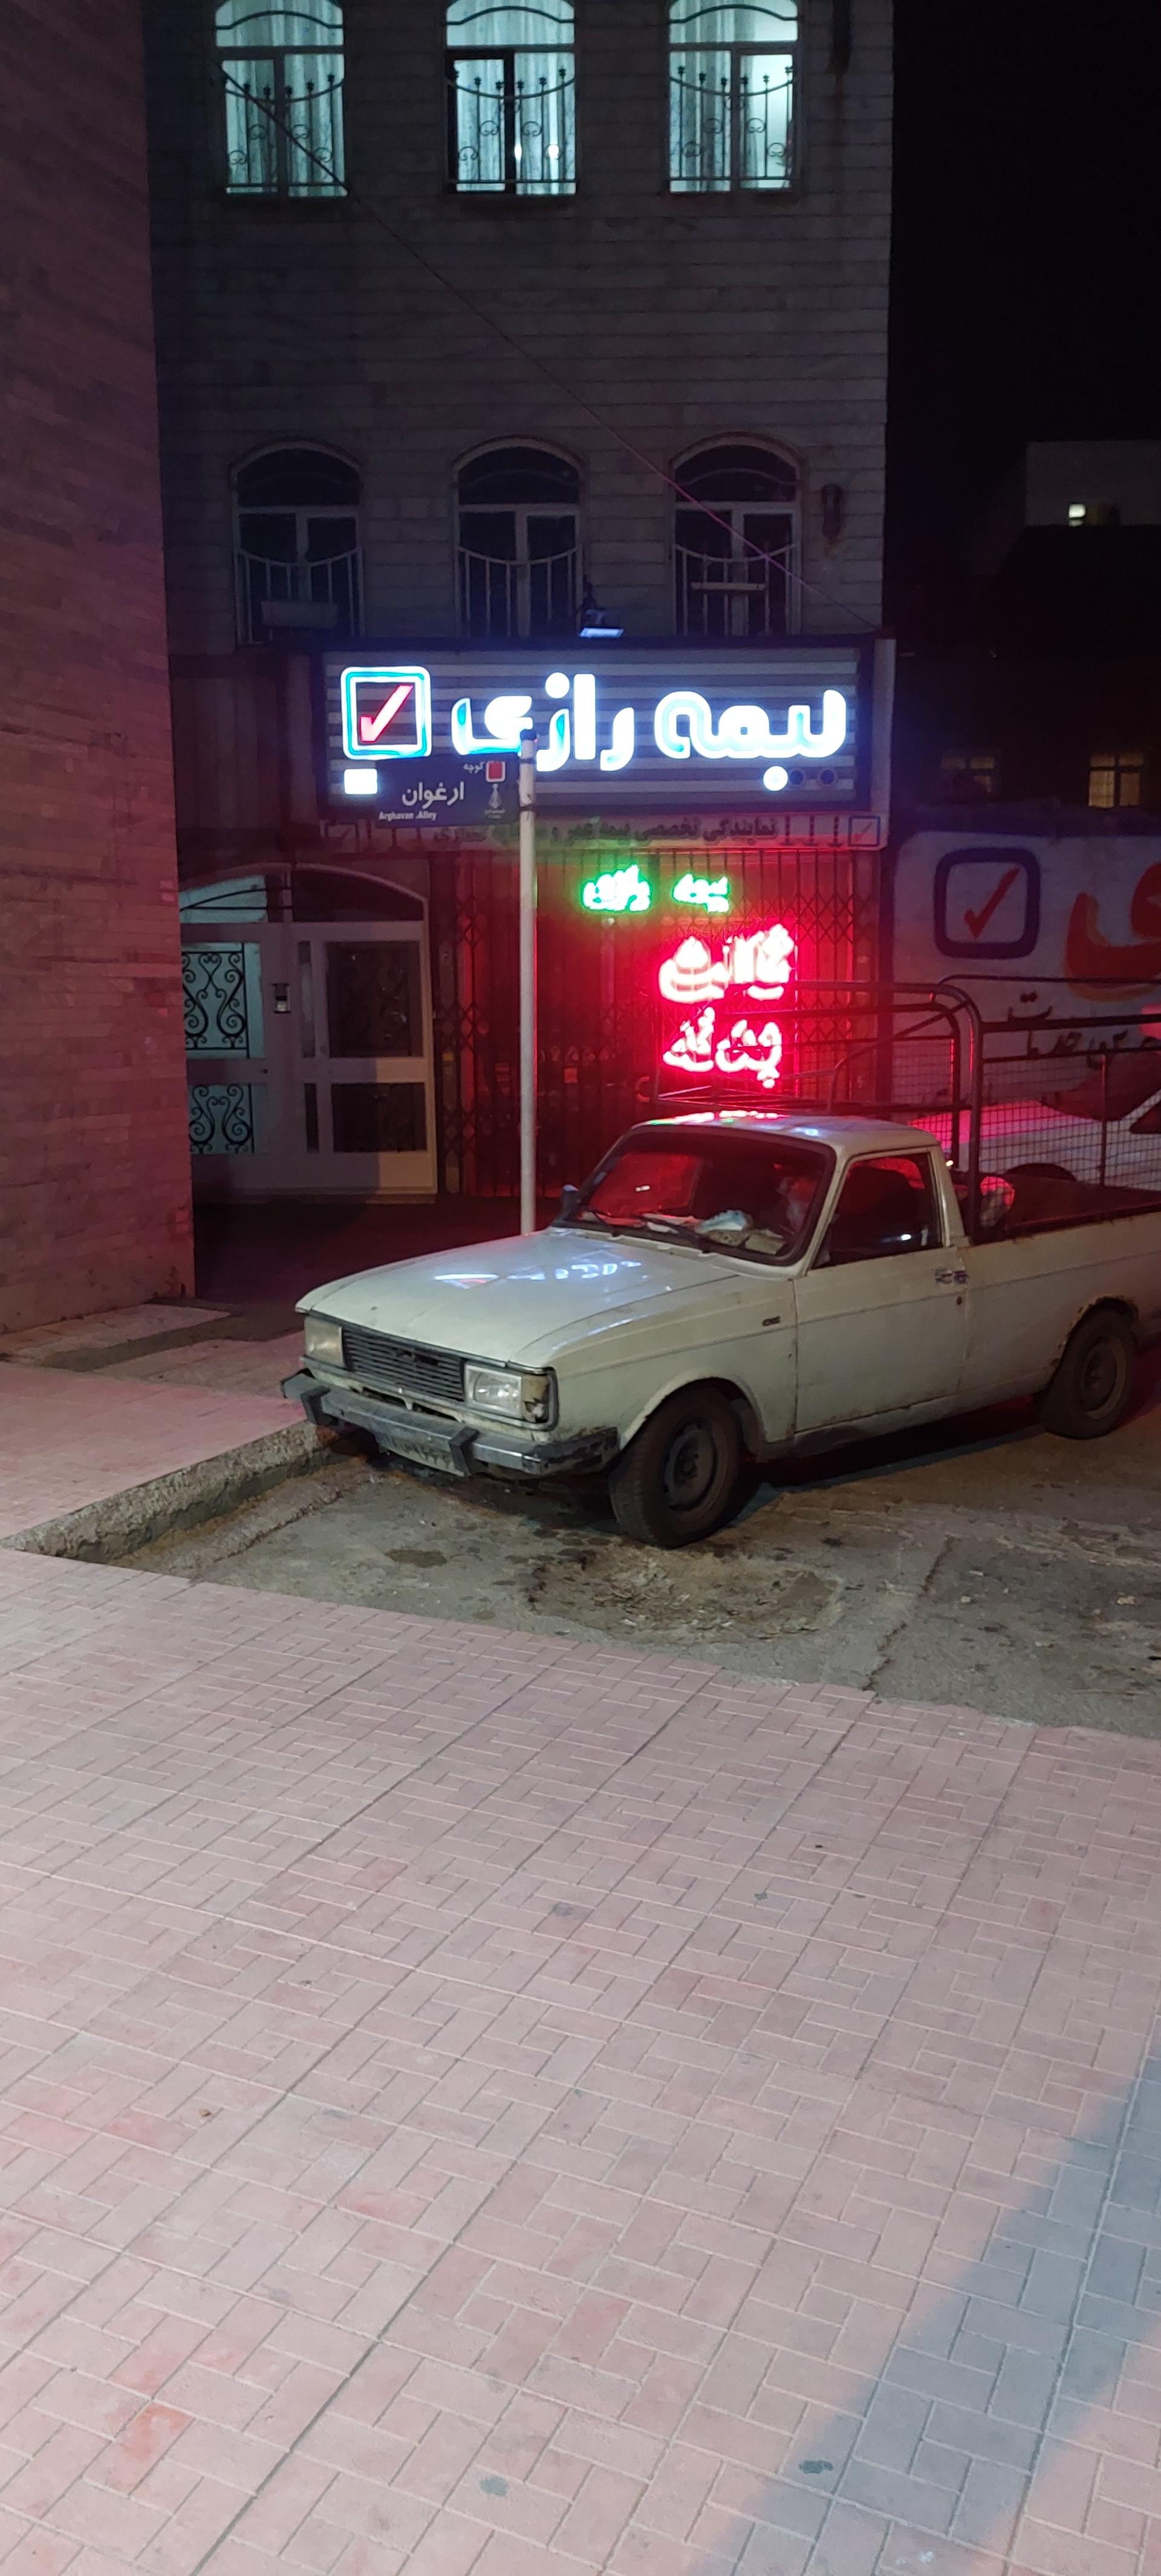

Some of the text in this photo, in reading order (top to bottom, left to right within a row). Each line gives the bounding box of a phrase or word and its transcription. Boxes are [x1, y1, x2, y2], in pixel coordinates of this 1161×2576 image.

[451, 671, 848, 792] بیمه رازی
[463, 762, 484, 774] کوچه
[402, 781, 464, 809] ارغوان
[379, 812, 414, 822] Arghavan
